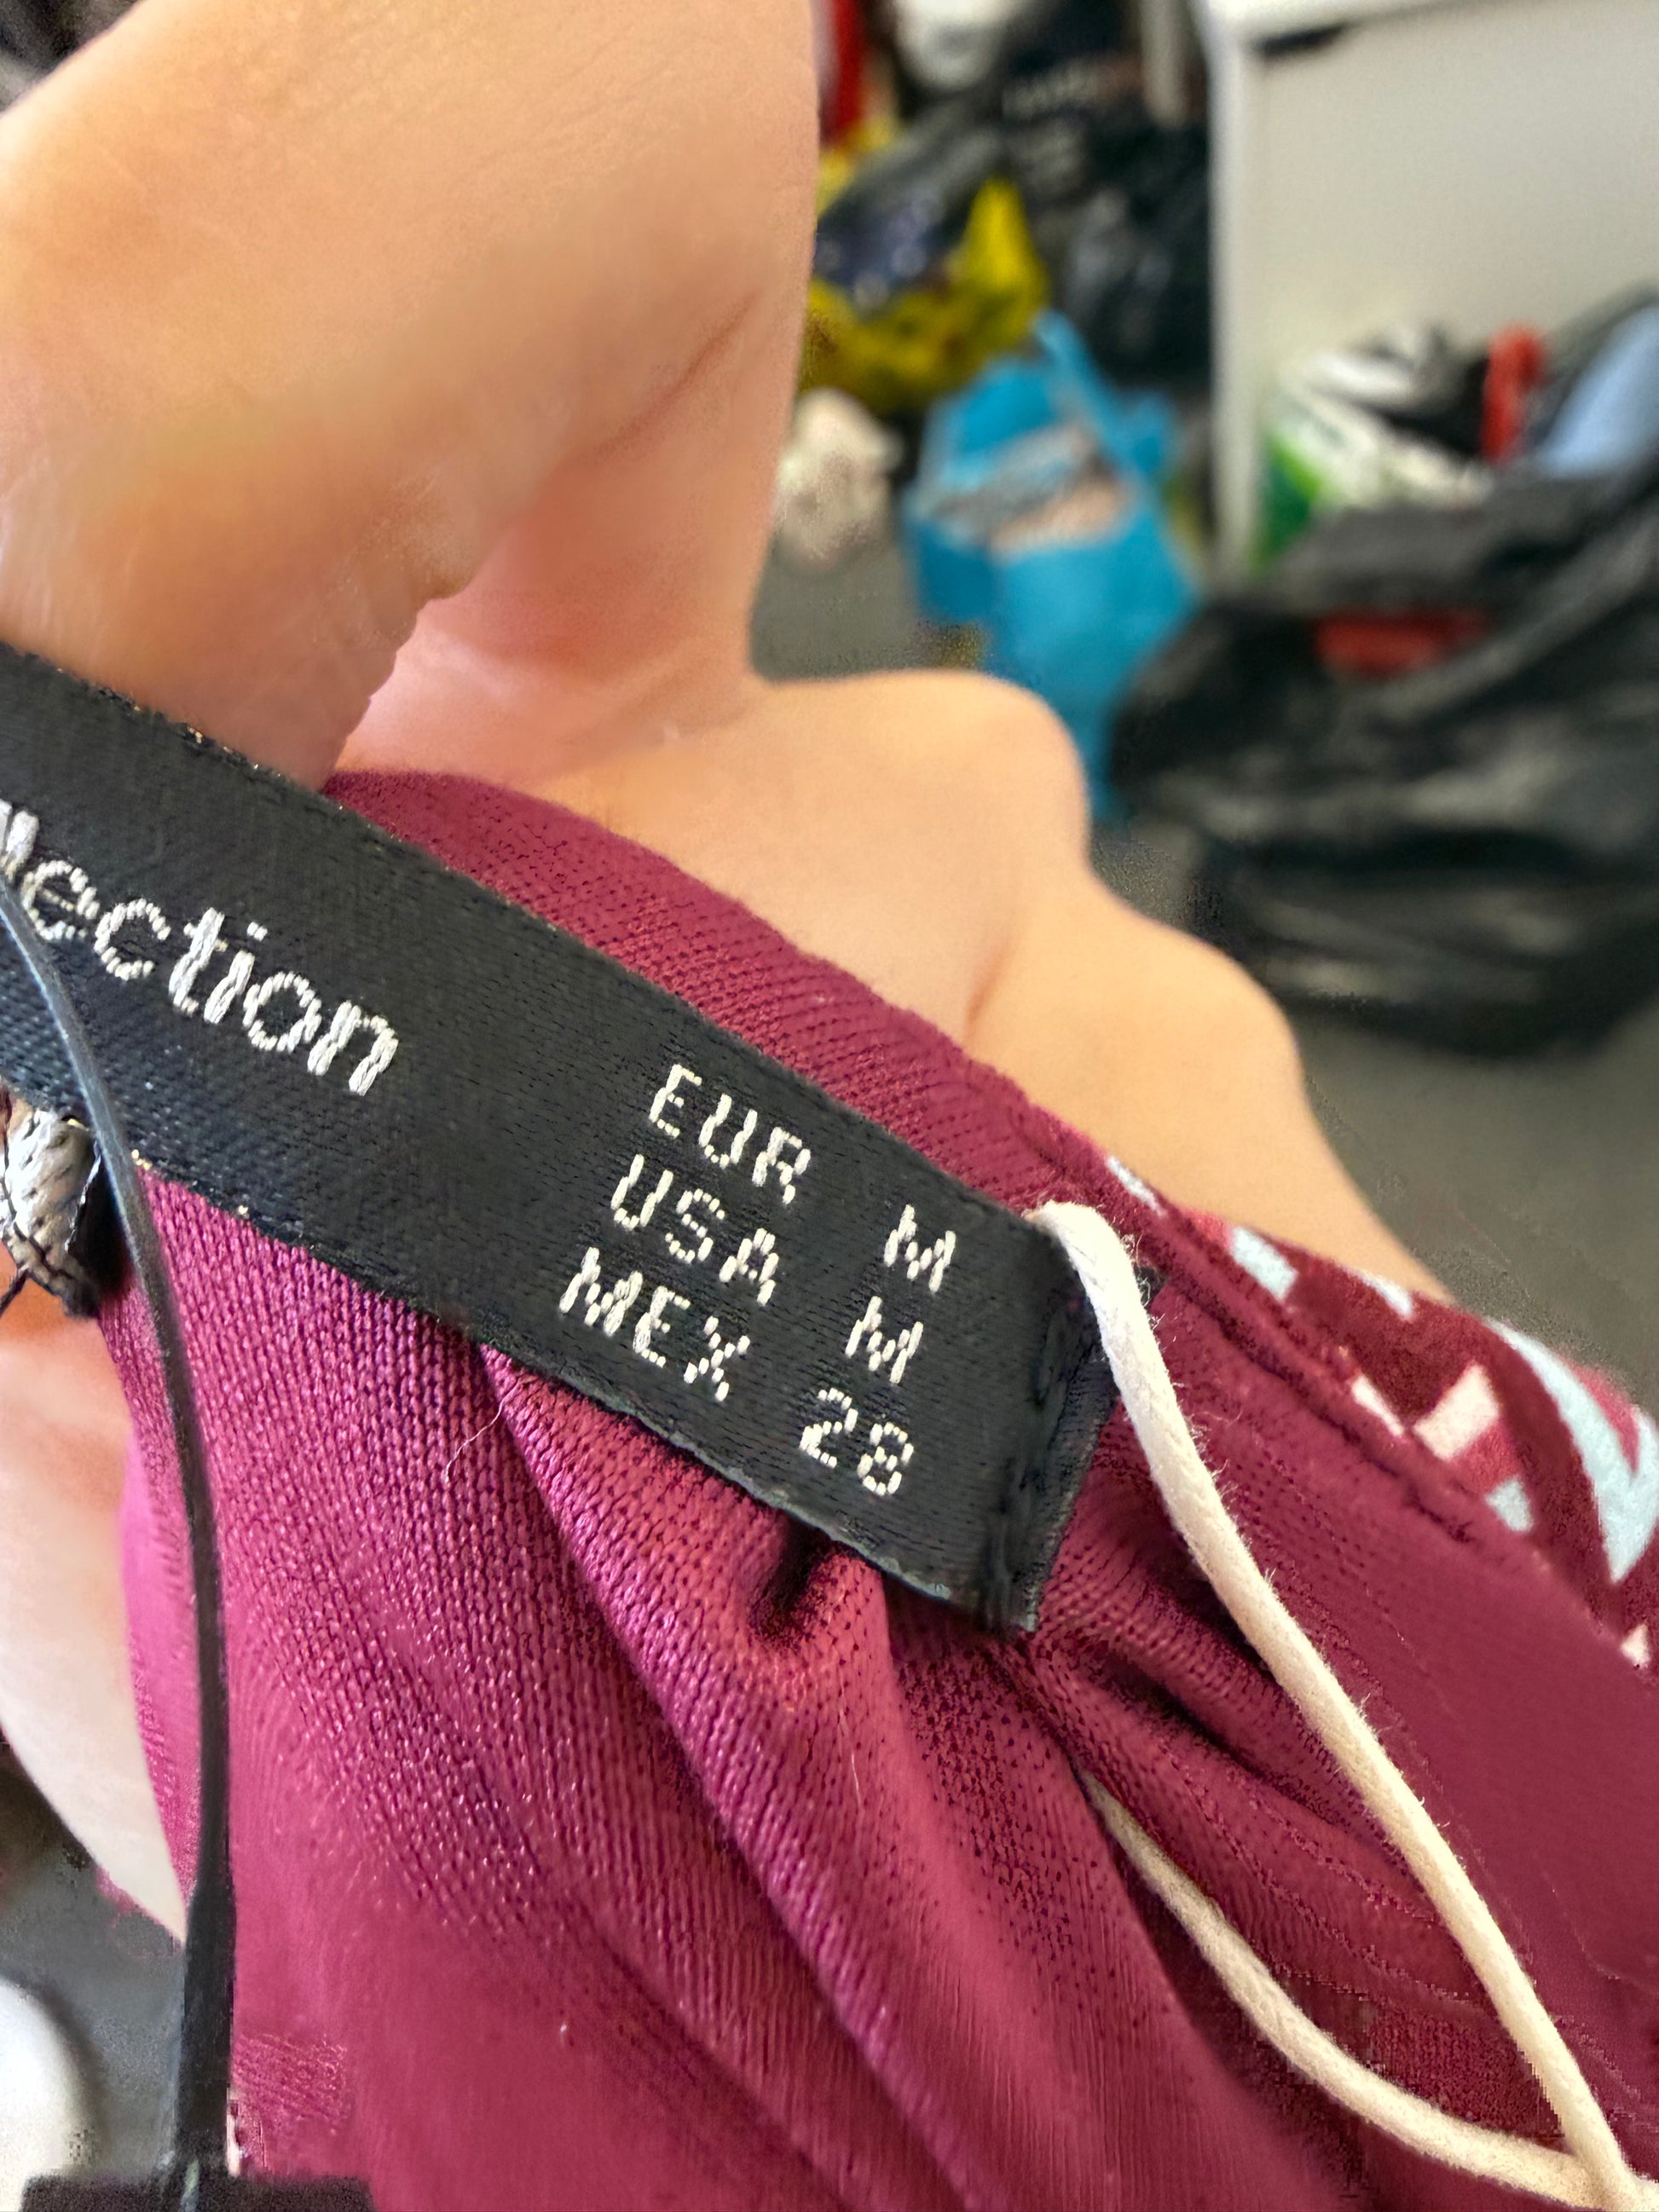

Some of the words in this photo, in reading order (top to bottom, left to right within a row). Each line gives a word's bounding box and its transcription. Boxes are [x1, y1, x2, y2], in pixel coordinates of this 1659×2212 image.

[610, 1154, 779, 1306] USA
[845, 1296, 923, 1383] M
[650, 1064, 811, 1204] EUR
[883, 1204, 957, 1293] M
[559, 1247, 751, 1401] MEX
[800, 1388, 914, 1496] 28
